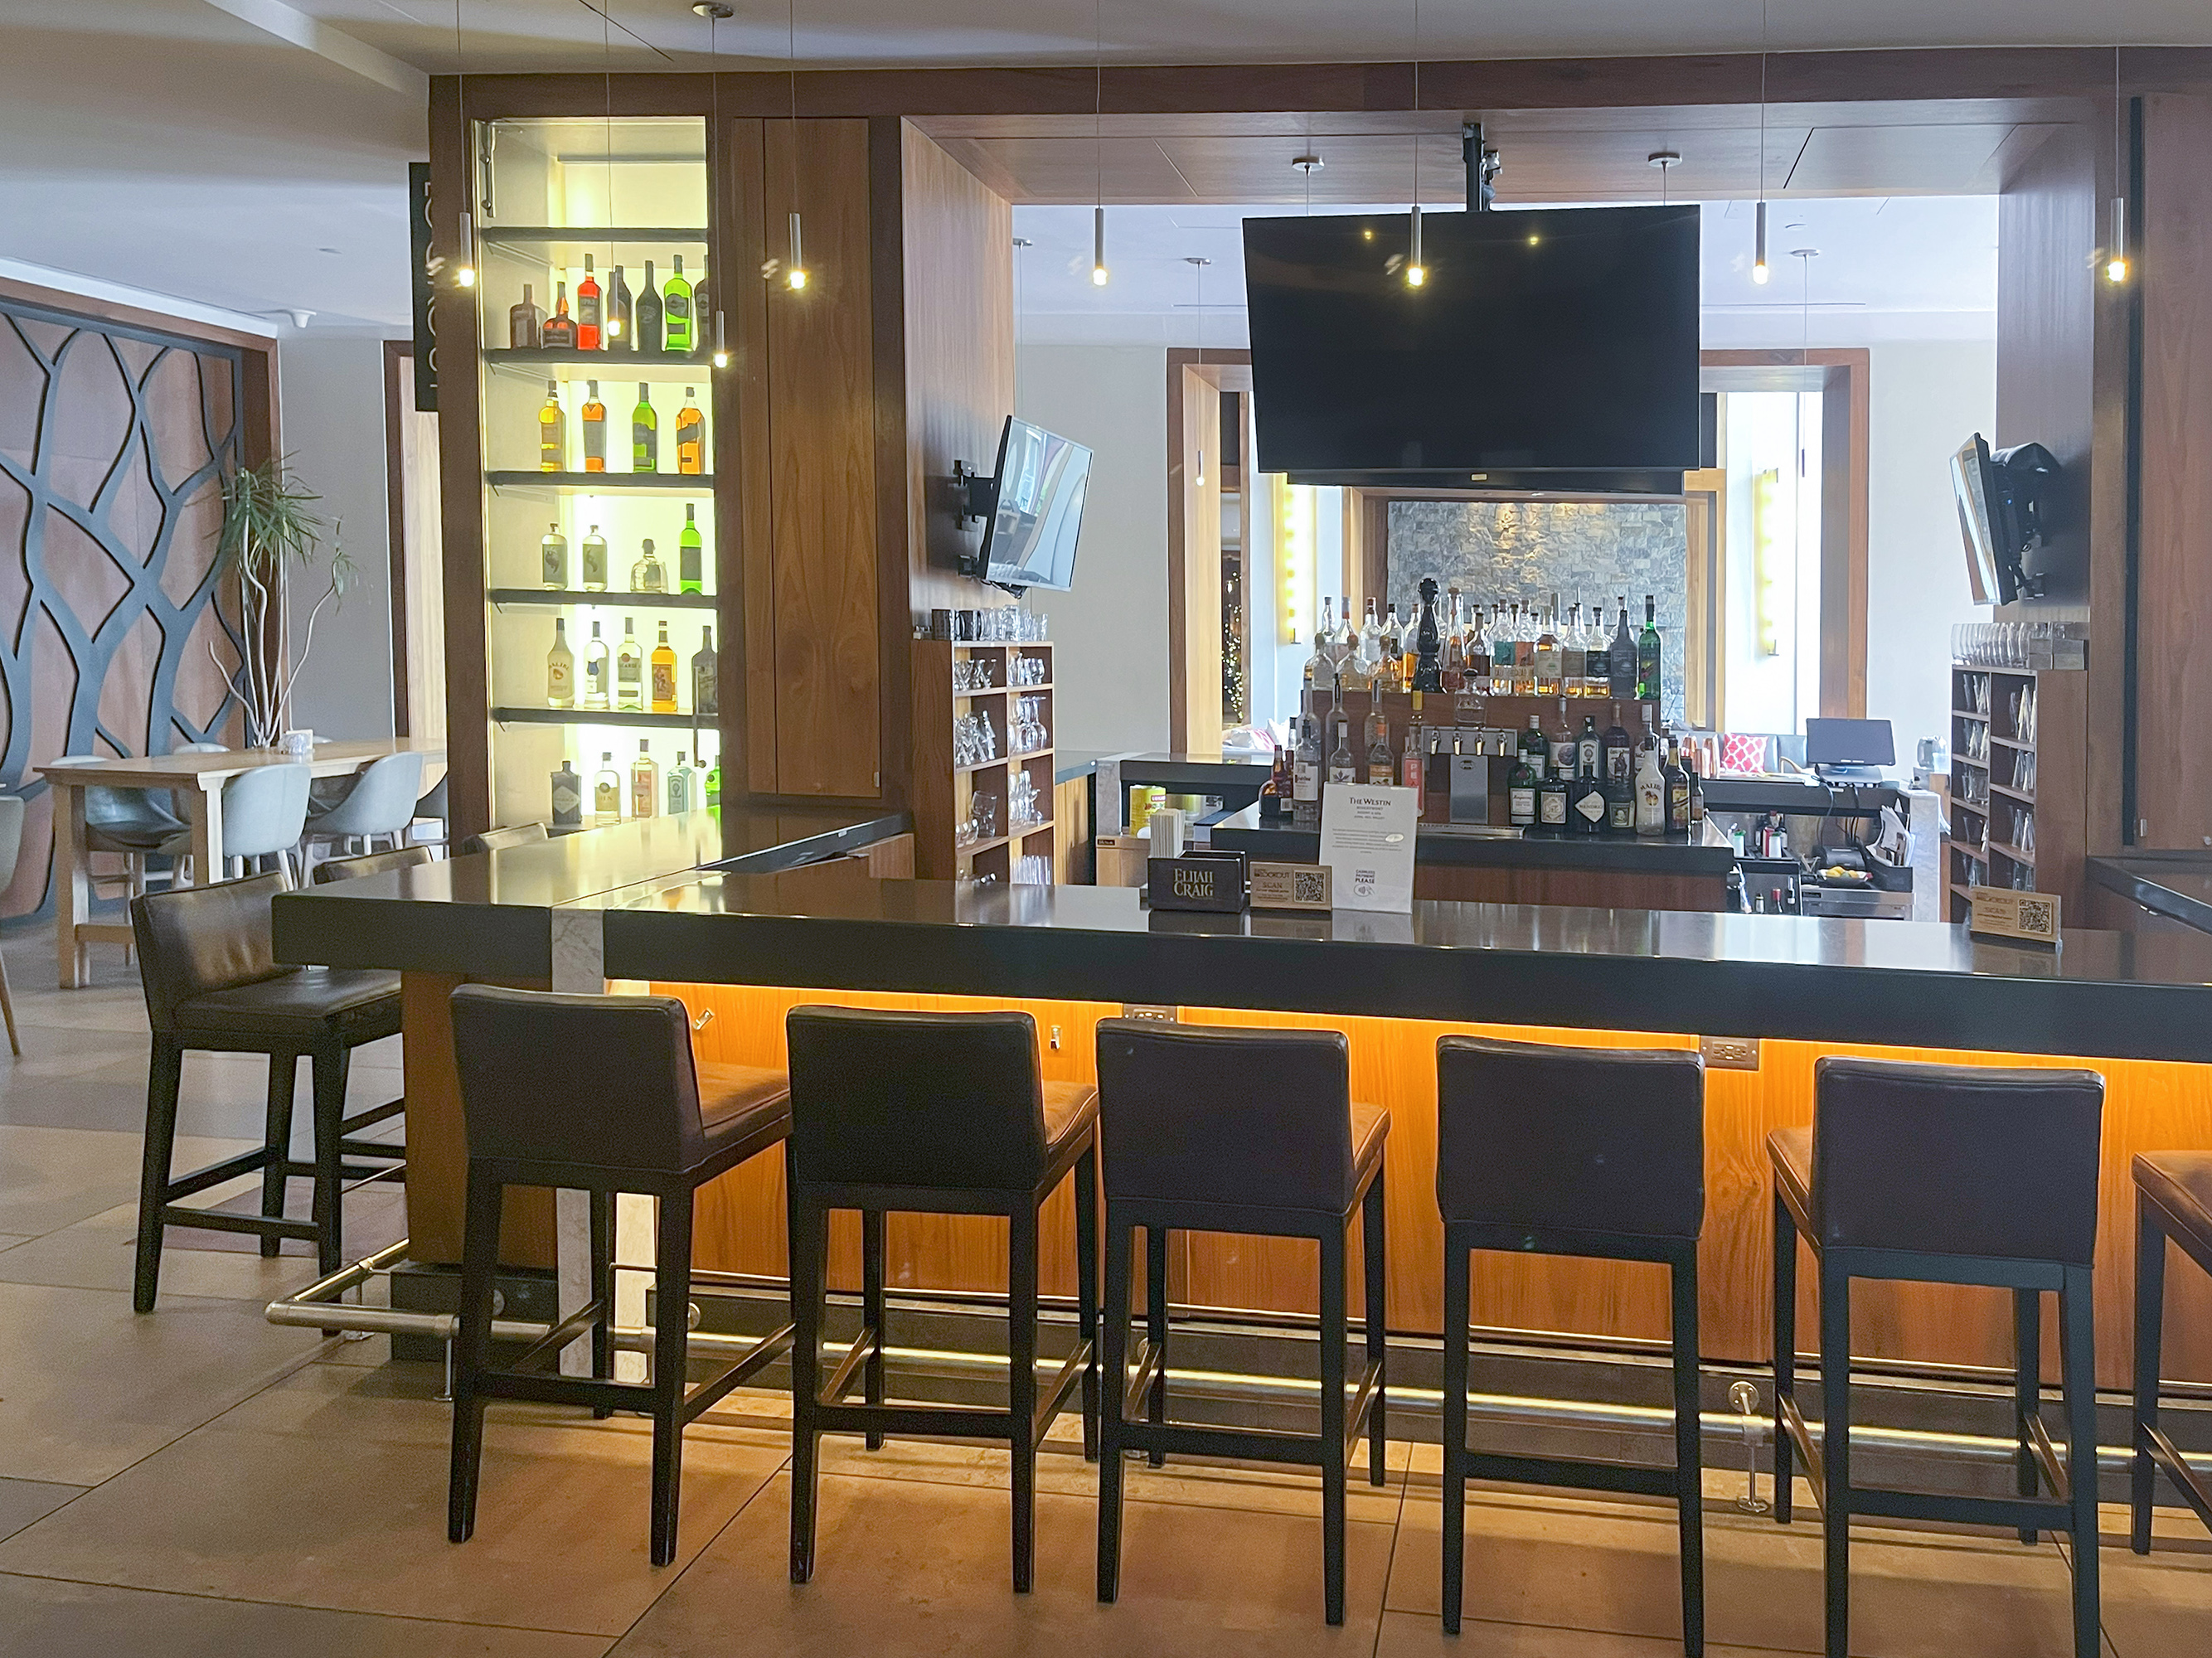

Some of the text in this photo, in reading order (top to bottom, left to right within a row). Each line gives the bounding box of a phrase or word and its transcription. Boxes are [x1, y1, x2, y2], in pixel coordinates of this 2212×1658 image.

[1350, 797, 1392, 806] THE WESTIN
[1174, 868, 1213, 884] ELIJAH
[1174, 881, 1214, 899] CRAIG
